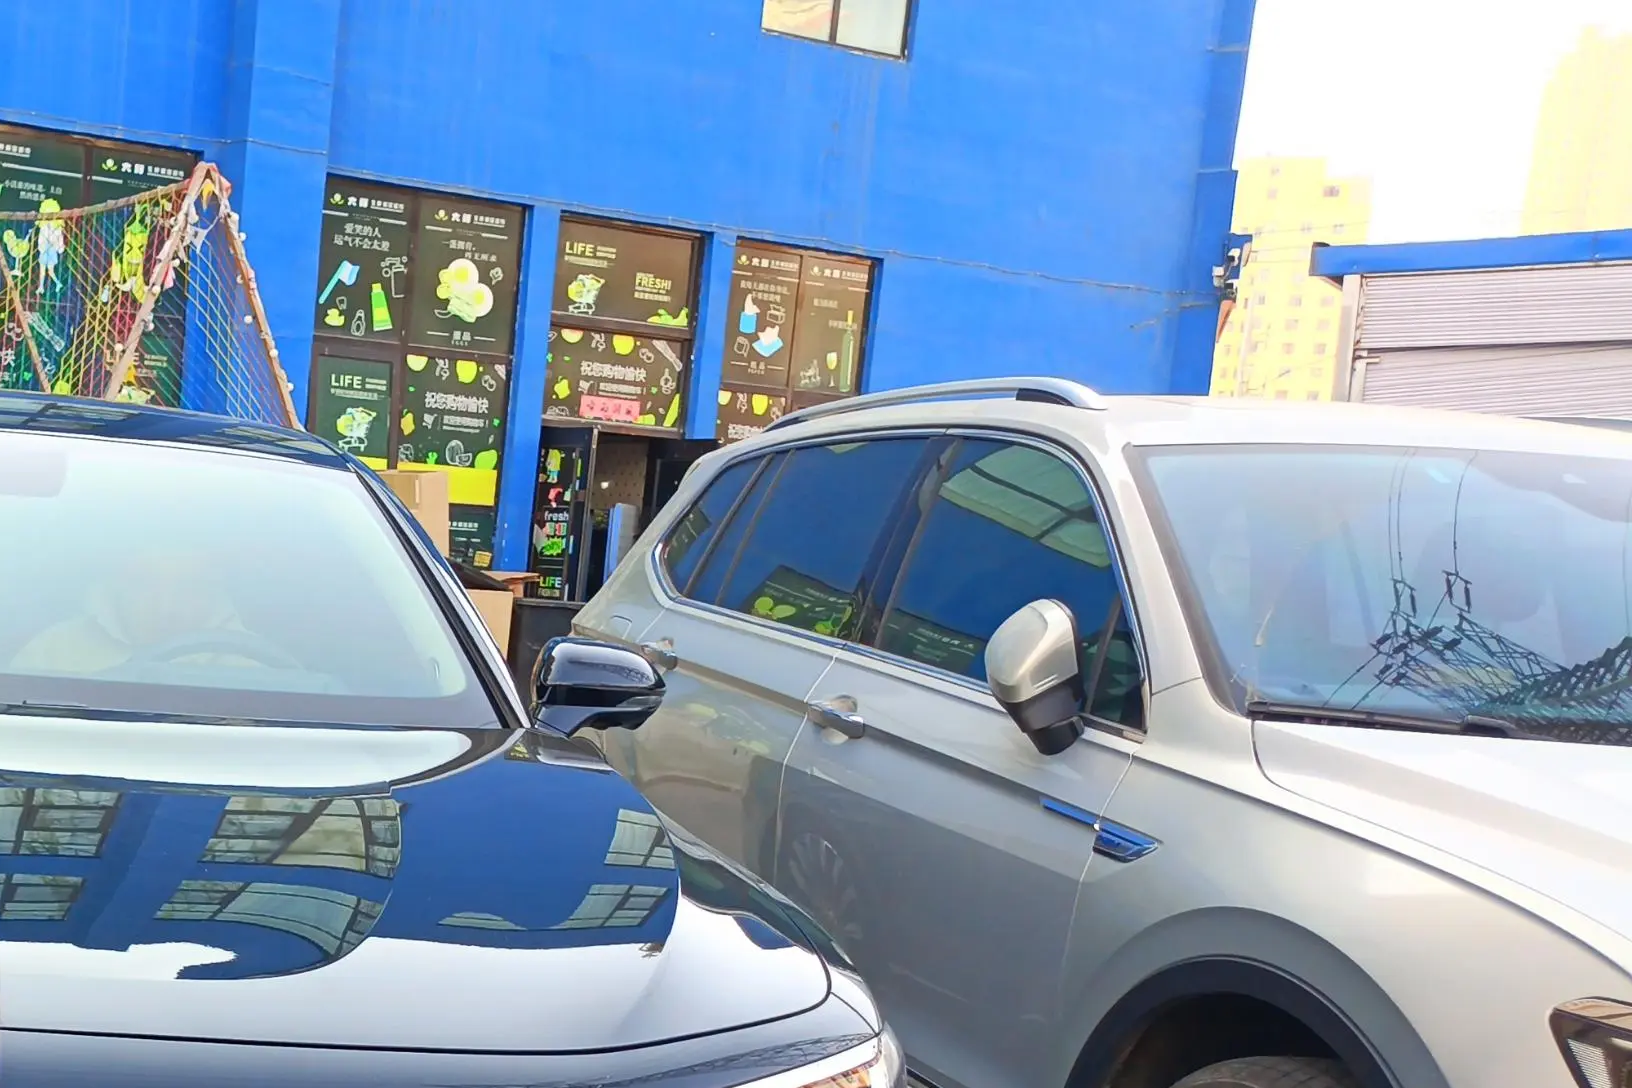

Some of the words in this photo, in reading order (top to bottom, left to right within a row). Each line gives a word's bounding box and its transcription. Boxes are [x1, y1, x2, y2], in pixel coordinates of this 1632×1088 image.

[565, 241, 595, 257] LIFE
[635, 275, 672, 290] FRESH!
[579, 360, 647, 382] 祝您购物愉快
[331, 374, 362, 389] LIFE
[424, 391, 489, 414] 祝您购物愉快
[539, 576, 562, 588] LIFE
